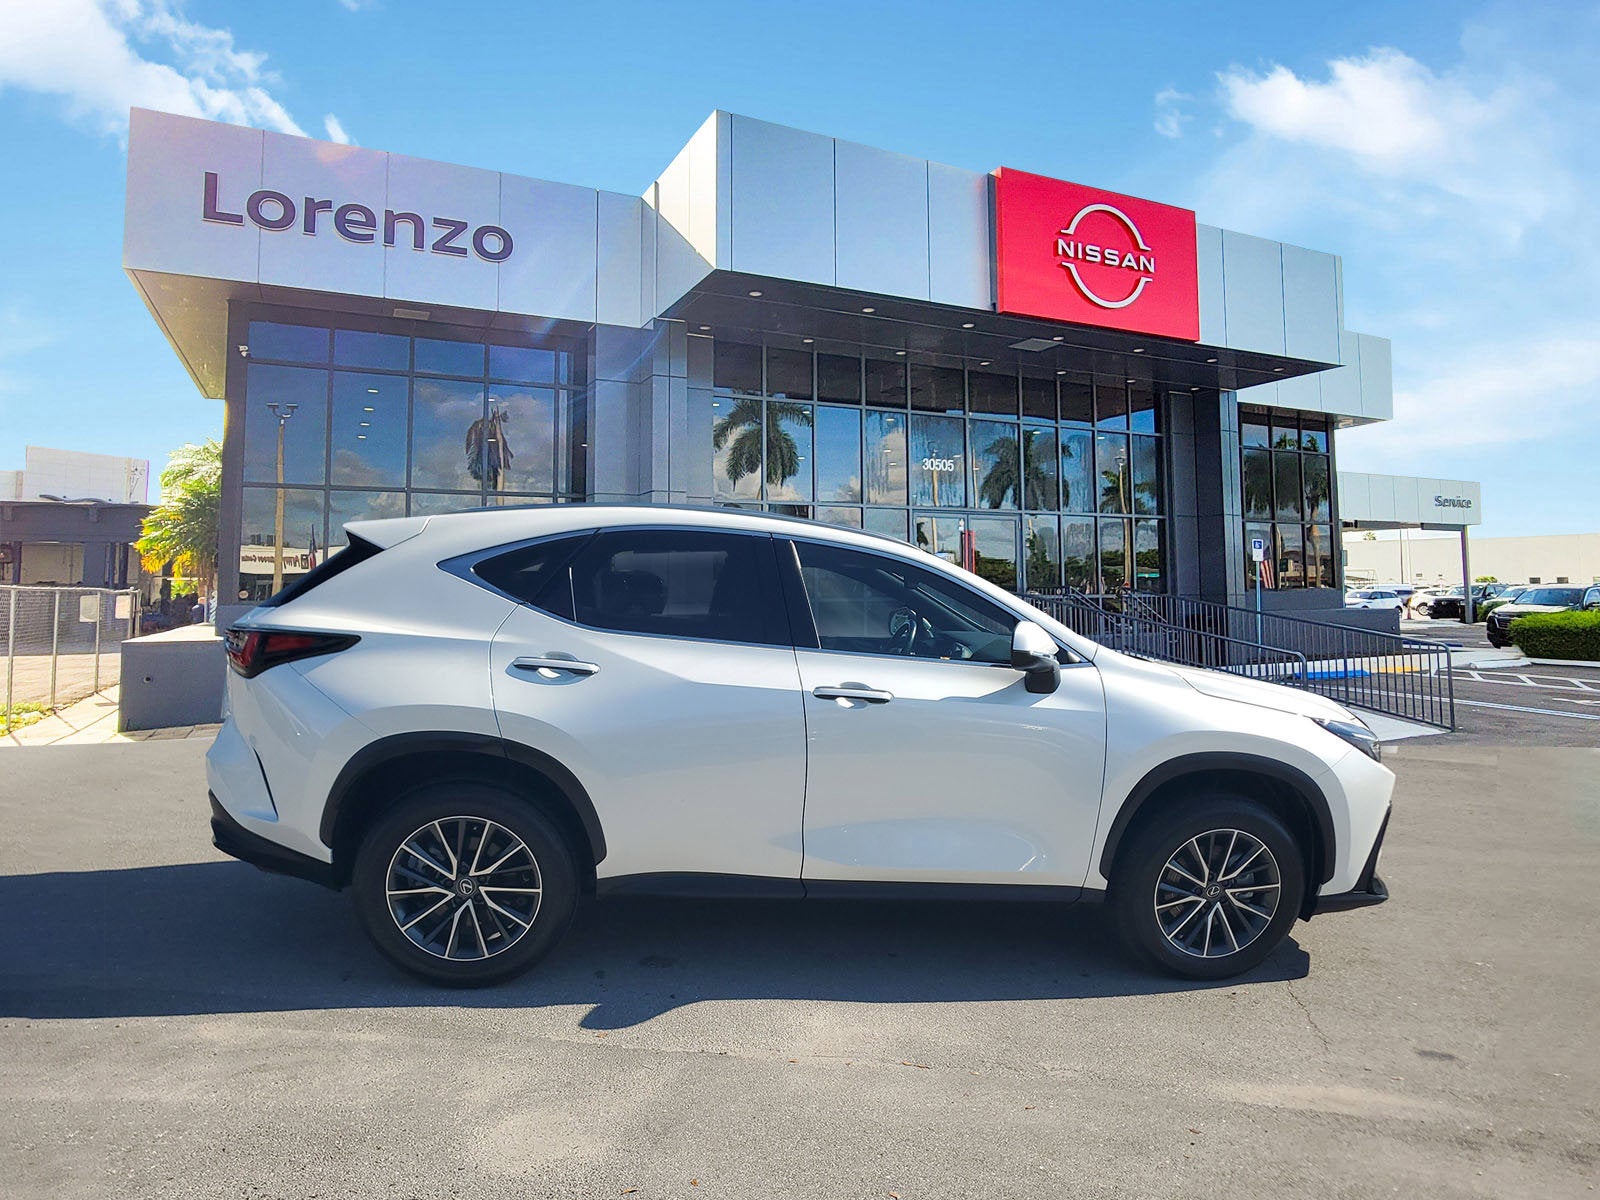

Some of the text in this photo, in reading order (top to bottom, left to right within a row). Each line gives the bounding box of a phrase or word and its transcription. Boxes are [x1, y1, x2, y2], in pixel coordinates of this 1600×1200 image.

[202, 171, 514, 262] Lorenzo
[1057, 238, 1155, 273] NISSAN
[922, 458, 955, 472] 30505
[1434, 495, 1472, 509] Service
